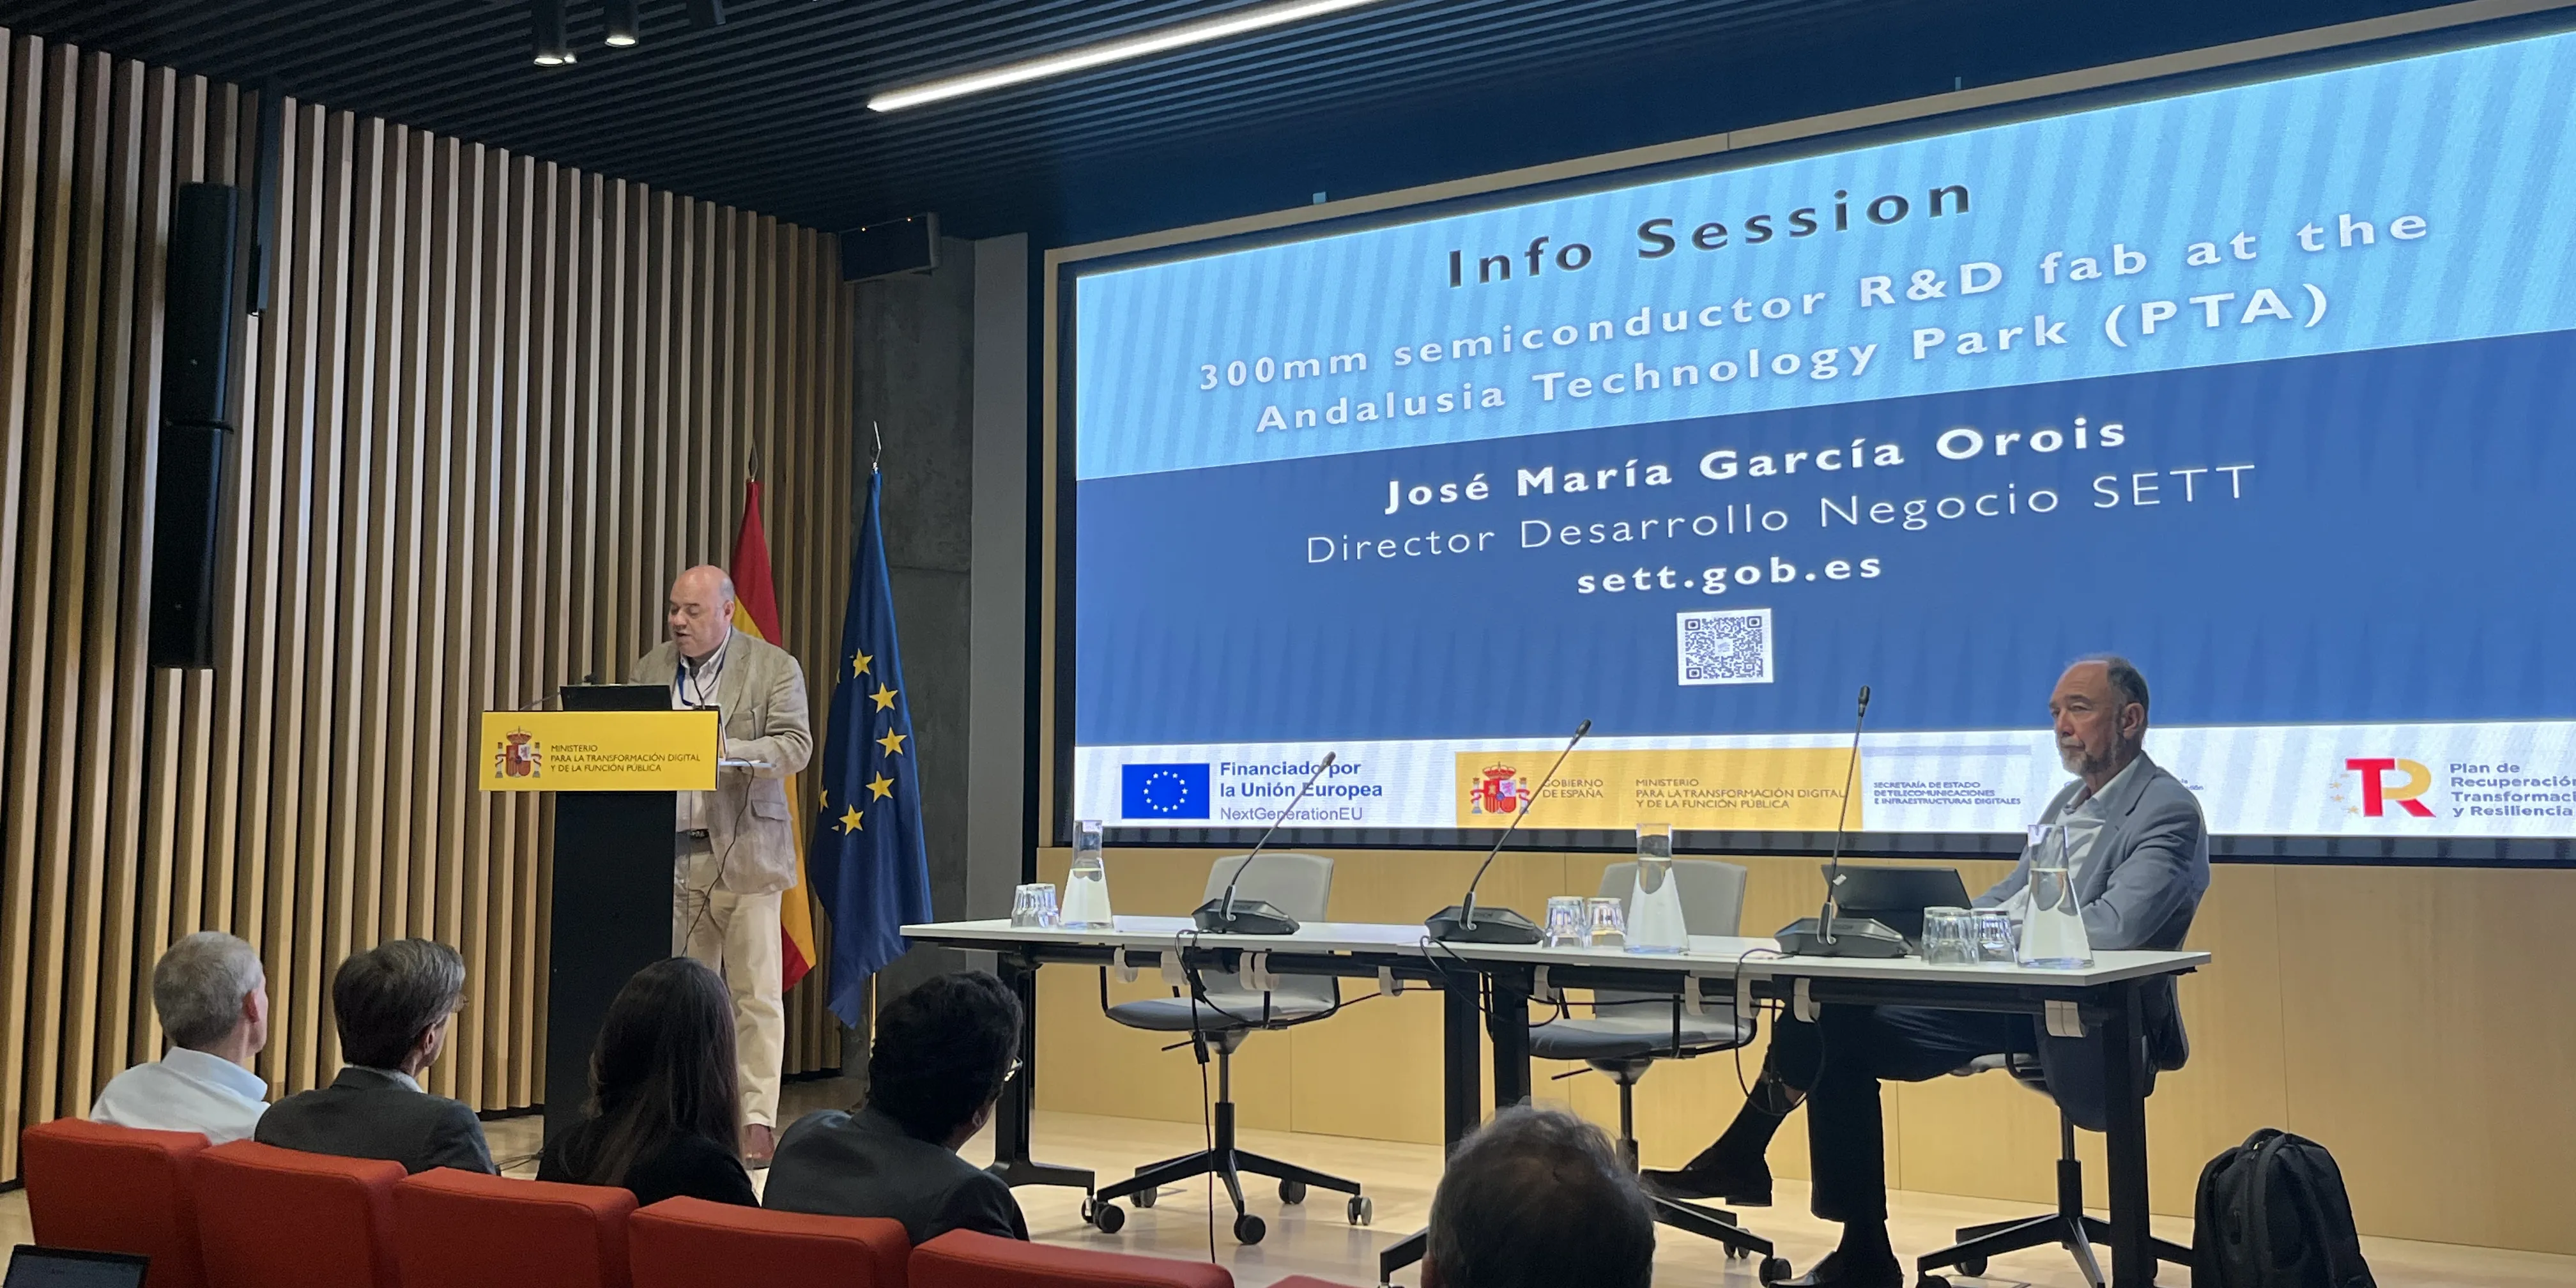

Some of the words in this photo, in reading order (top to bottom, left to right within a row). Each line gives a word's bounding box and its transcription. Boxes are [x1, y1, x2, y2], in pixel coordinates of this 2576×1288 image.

[1448, 236, 1593, 289] Info
[1636, 183, 1970, 260] Session
[1200, 352, 1367, 391] 300mm
[1394, 291, 1825, 367] semiconductor
[1859, 261, 2002, 308] R&D
[2039, 243, 2147, 284] fab
[2186, 231, 2257, 267] at
[2296, 213, 2427, 252] the
[1255, 382, 1505, 433] Andalusia
[1532, 341, 1878, 402] Technology
[1912, 314, 2068, 360] Park
[2104, 283, 2327, 348] (PTA)
[1384, 473, 1489, 515] José
[1516, 459, 1673, 496] María
[1699, 438, 1905, 480] García
[1936, 417, 2126, 461] Orois
[1307, 529, 1495, 564] Director
[1521, 503, 1788, 549] Desarrollo
[1820, 482, 2058, 530] Negocio
[2092, 464, 2255, 509] SETT
[1577, 555, 1881, 595] sett.gob.es
[586, 752, 665, 762] TRANSFORMACIÓN
[585, 763, 624, 772] FUNCIÓN
[626, 763, 661, 772] PÚBLICA
[1220, 761, 1323, 776] Financiado
[1329, 763, 1361, 778] por
[2450, 763, 2490, 774] Plan
[2496, 762, 2520, 773] de
[1543, 779, 1604, 787] GOBIERNO
[1636, 779, 1699, 787] MINISTERIO
[1220, 783, 1235, 797] la
[1241, 782, 1295, 797] Unión
[1302, 782, 1383, 800] Europea
[1542, 790, 1557, 798] DE
[1561, 788, 1604, 798] ESPAÑA
[1636, 790, 1664, 798] PARA
[1667, 790, 1682, 798] LA
[1683, 787, 1794, 798] TRANSFORMACIÓN
[1797, 789, 1846, 798] DIGITAL
[1636, 800, 1644, 808] Y
[1647, 800, 1662, 808] DE
[1665, 800, 1679, 808] LA
[1682, 799, 1736, 808] FUNCIÓN
[1740, 799, 1790, 808] PÚBLICA
[1220, 807, 1363, 820] NextGenerationEU
[2452, 808, 2464, 818] y
[2470, 805, 2573, 816] Resiliencia
